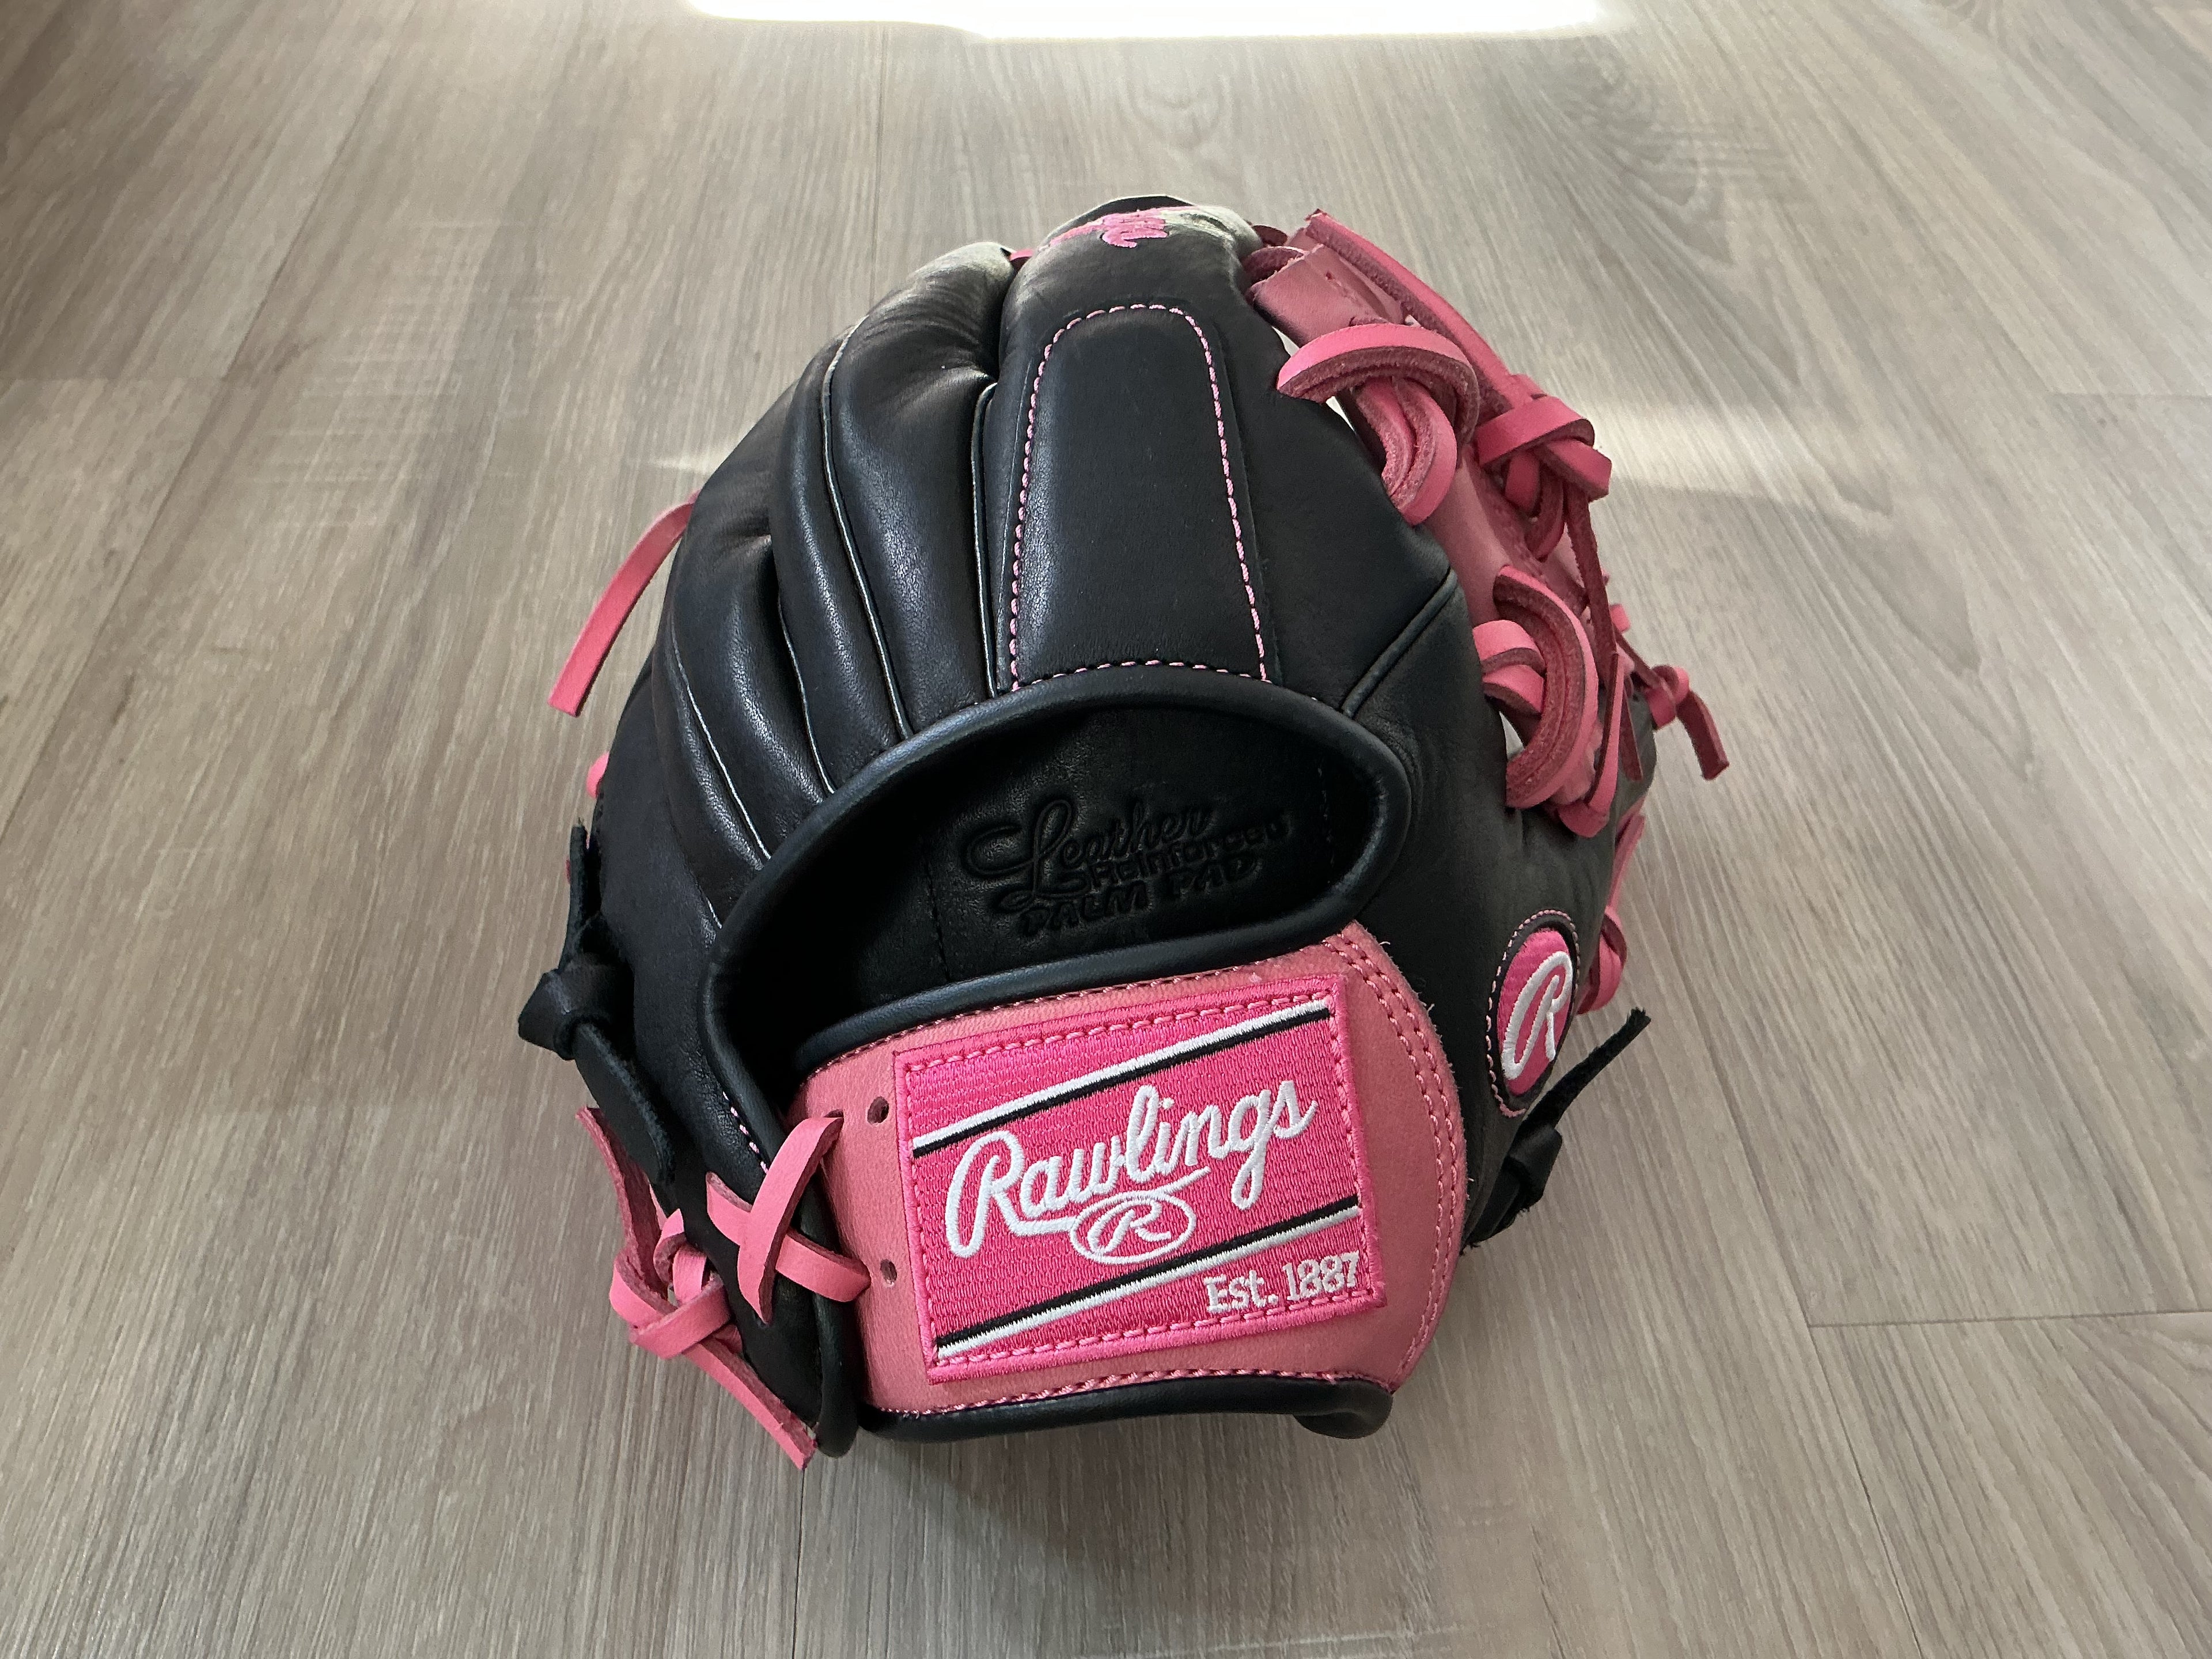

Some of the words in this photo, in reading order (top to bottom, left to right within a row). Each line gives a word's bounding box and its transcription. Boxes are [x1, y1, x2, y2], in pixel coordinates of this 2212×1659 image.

[961, 795, 1214, 912] Leather
[1020, 880, 1149, 937] PALM
[1164, 850, 1258, 900] PAD
[1501, 951, 1573, 1080] R
[945, 1081, 1318, 1259] Rawlings
[1203, 1269, 1279, 1313] Est.
[1282, 1250, 1359, 1300] 1887
